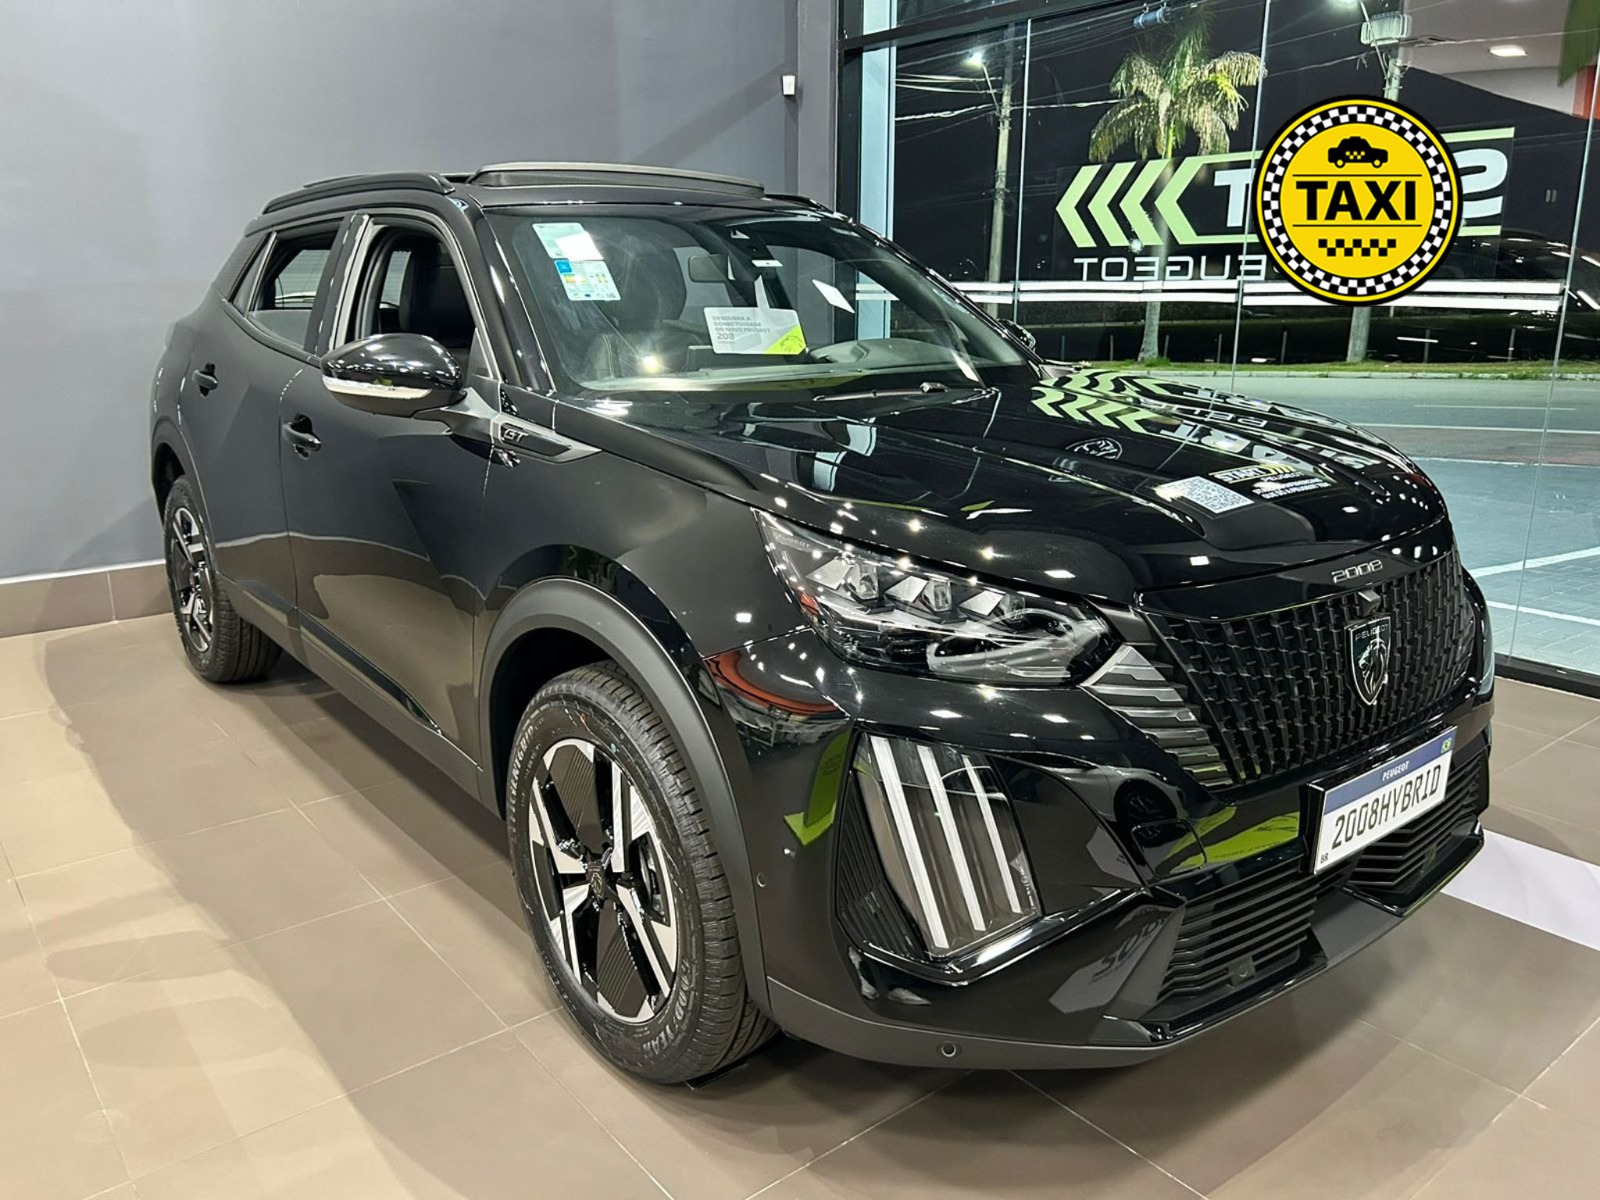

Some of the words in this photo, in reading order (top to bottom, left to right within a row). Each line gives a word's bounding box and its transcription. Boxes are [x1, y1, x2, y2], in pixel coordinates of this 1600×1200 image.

[504, 428, 529, 443] GT
[1331, 559, 1383, 584] 2008
[1381, 760, 1410, 782] PEUGEOT
[1331, 764, 1442, 850] 2008HYBRID
